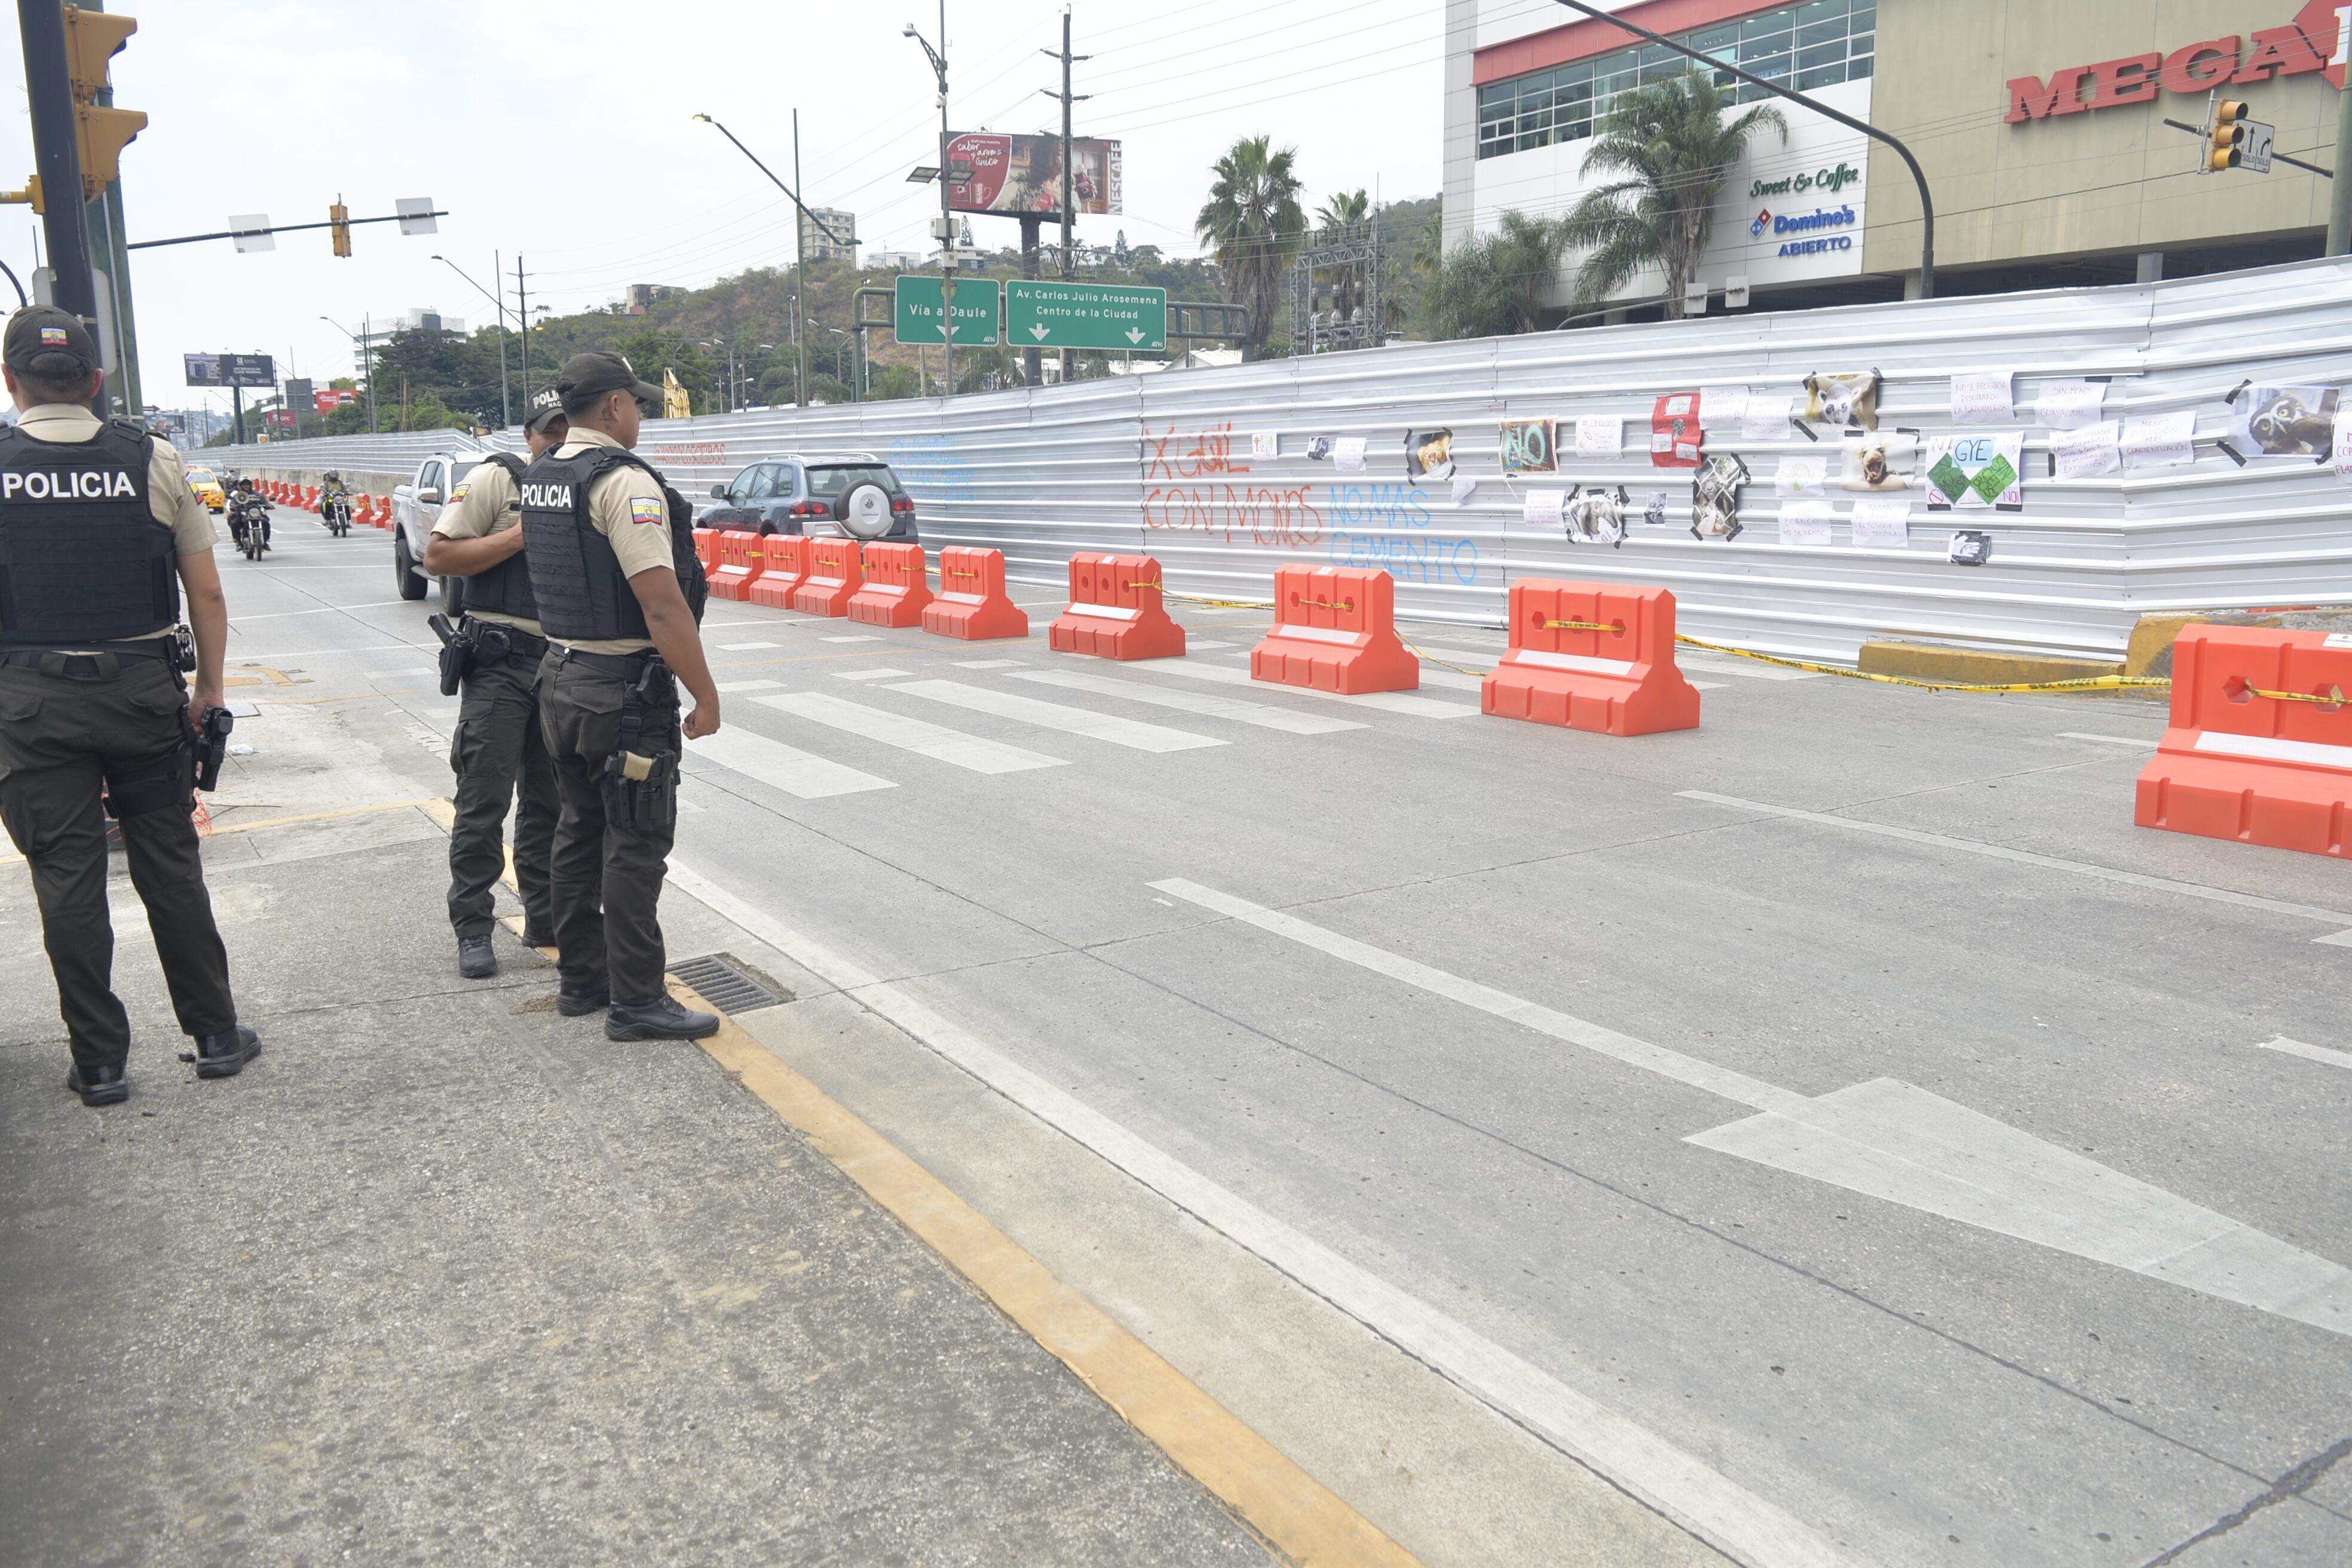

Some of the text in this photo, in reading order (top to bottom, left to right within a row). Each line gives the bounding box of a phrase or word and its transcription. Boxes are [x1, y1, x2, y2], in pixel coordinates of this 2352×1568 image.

[957, 140, 979, 151] sabor
[2257, 157, 2269, 166] SOLO
[1750, 163, 1858, 197] Sweet & Coffee
[1774, 204, 1855, 234] Domino's
[1778, 236, 1851, 256] ABIERTO
[1016, 289, 1157, 305] Av. Carlos Julio Arosemena
[909, 304, 987, 317] Vía a Daule
[1036, 306, 1138, 319] Centro de la Ciudad
[2054, 385, 2066, 396] SIN
[1964, 405, 2008, 414] NATURALEZA
[2040, 408, 2088, 417] GUAYAQUIL
[2142, 419, 2170, 428] MENOS
[1503, 423, 1546, 467] NO
[1955, 440, 1991, 462] GYE
[2, 471, 136, 498] POLICIA
[521, 484, 572, 508] POLICIA
[1330, 483, 1431, 528] NO MAS
[1145, 484, 1214, 534] CON
[1330, 531, 1478, 584] CEMENTO
